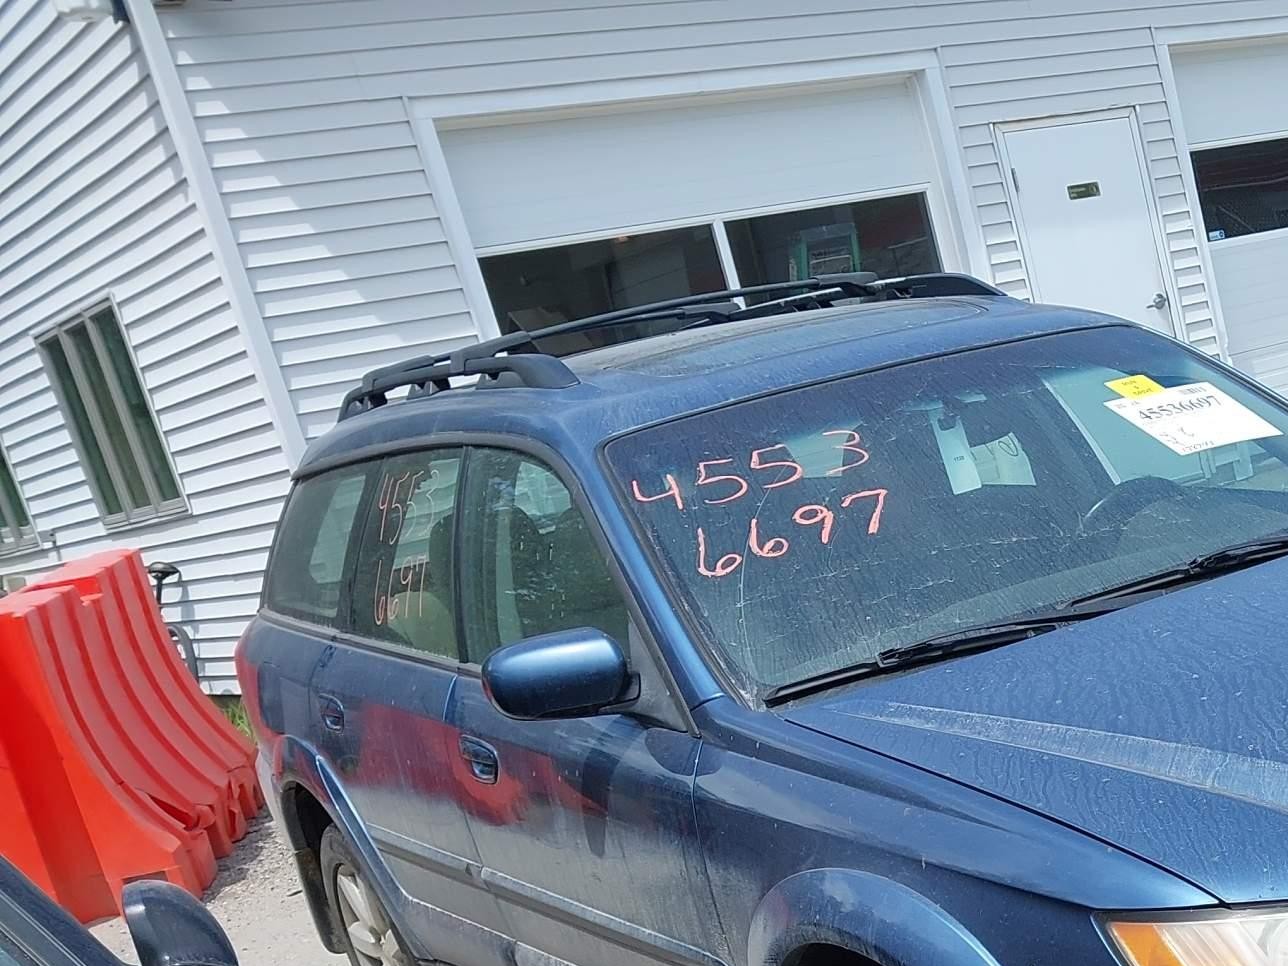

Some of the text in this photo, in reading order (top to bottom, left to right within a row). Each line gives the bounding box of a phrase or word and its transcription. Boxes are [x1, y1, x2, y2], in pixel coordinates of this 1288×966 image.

[1138, 395, 1222, 420] 45536697
[379, 470, 440, 545] 4553
[632, 430, 870, 510] 4553
[697, 488, 888, 577] 6697
[374, 555, 428, 626] 6697
